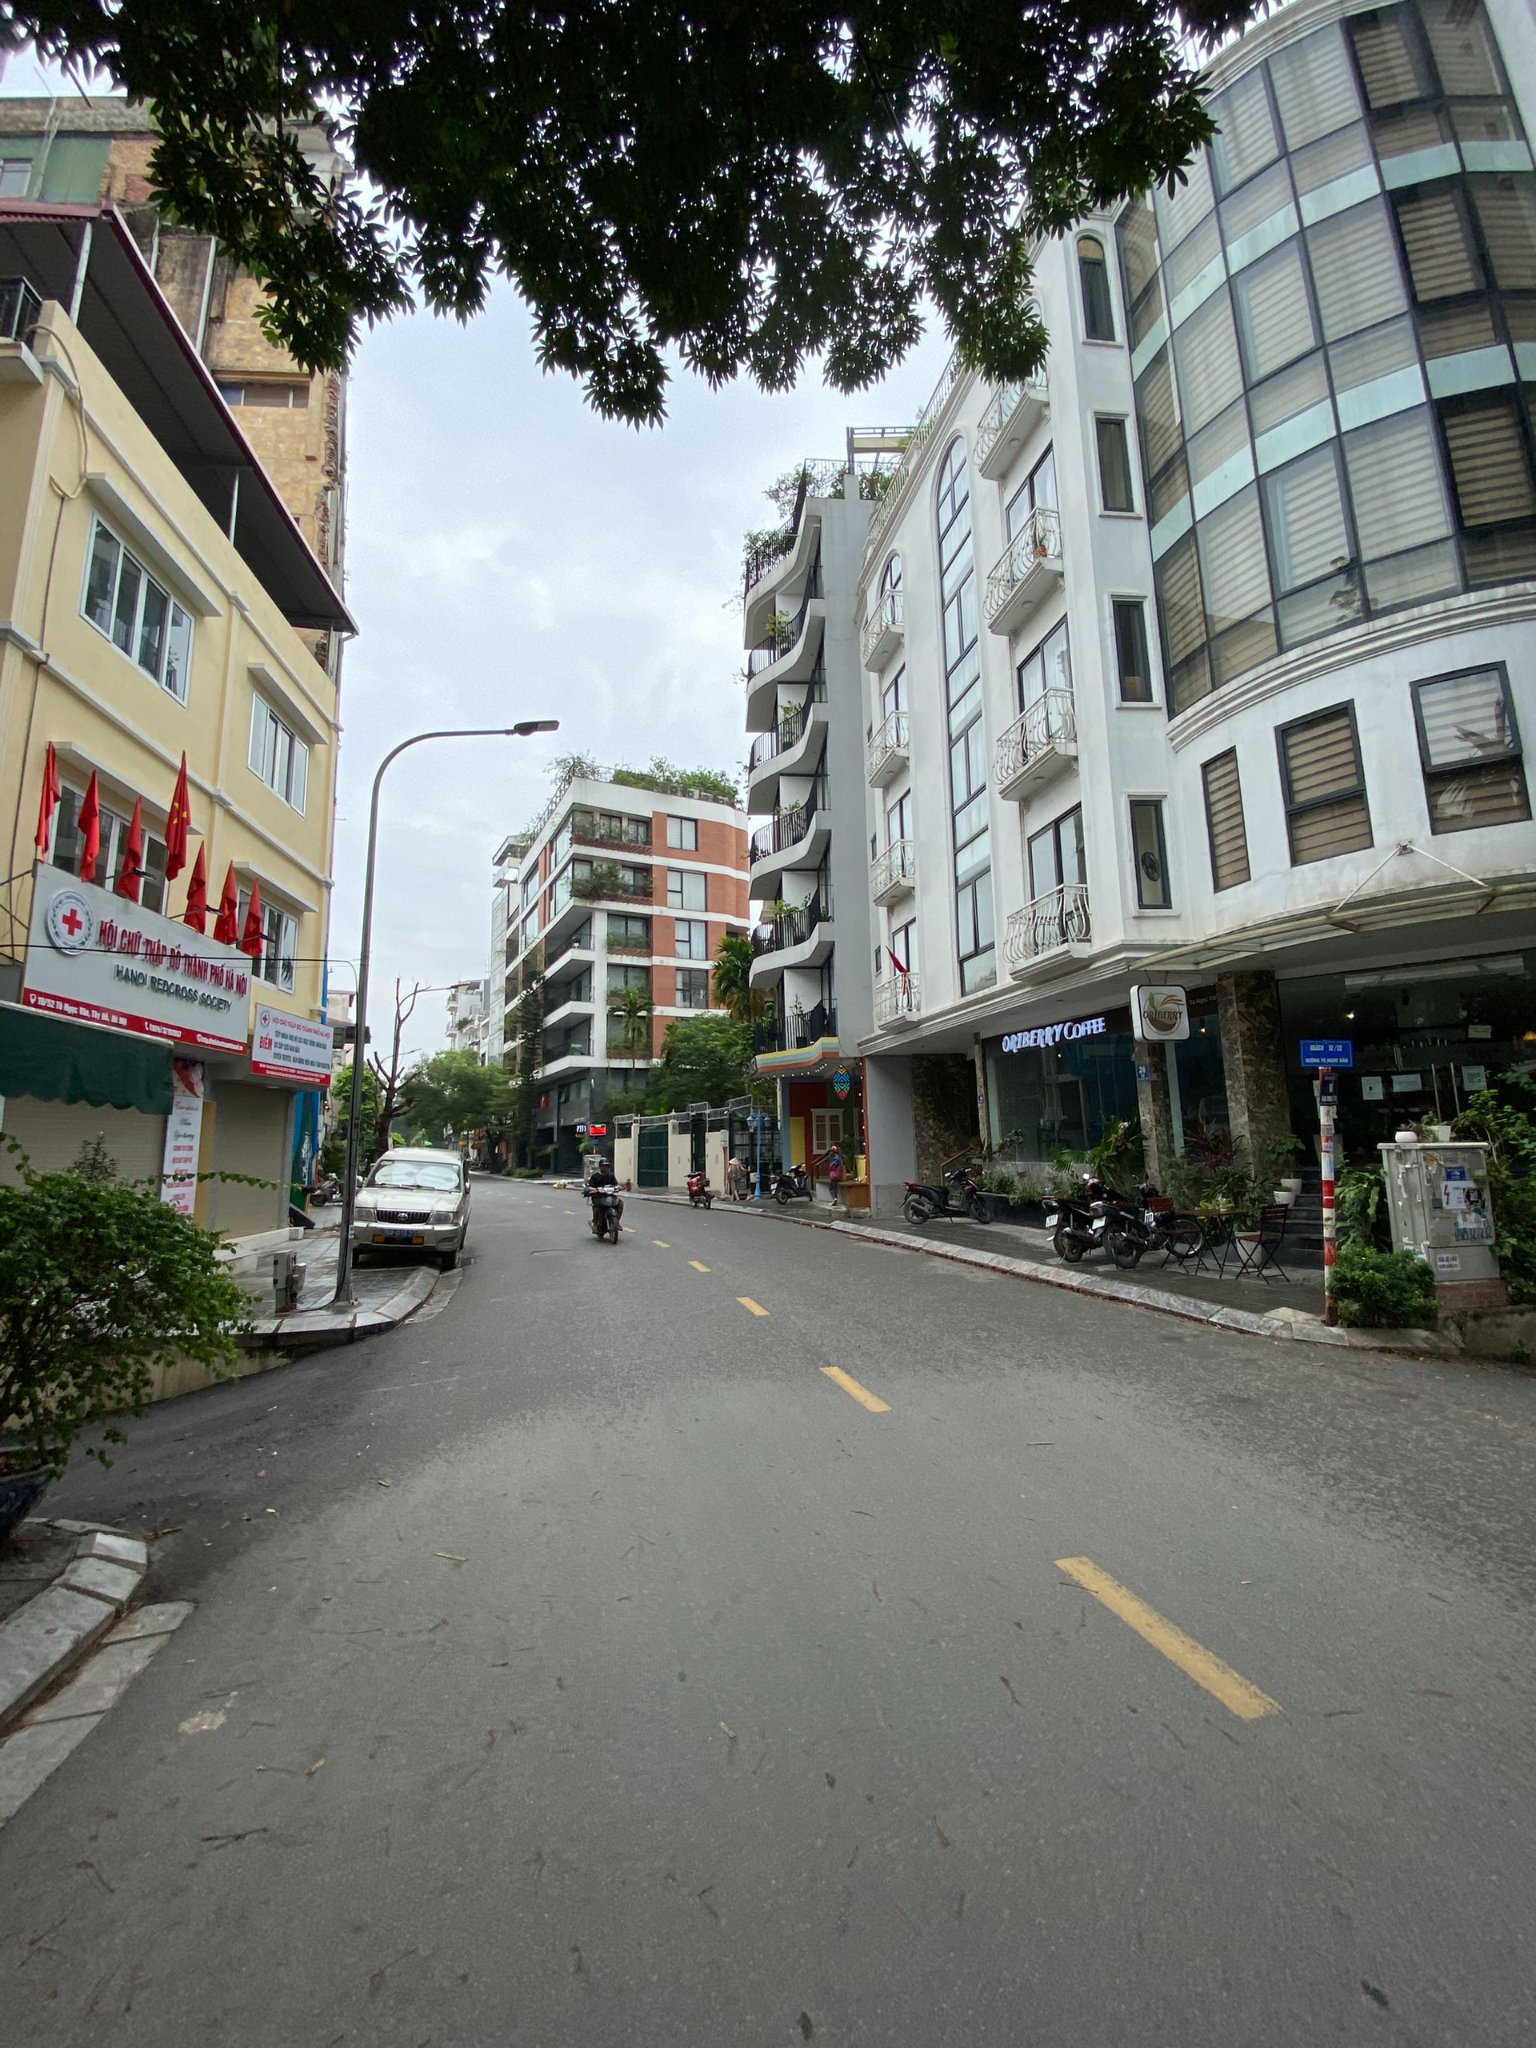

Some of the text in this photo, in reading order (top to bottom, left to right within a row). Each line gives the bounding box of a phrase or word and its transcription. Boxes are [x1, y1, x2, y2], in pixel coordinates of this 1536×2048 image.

[99, 919, 117, 951] HỘI
[120, 929, 142, 954] CHỮ
[209, 963, 225, 986] PHỐ
[225, 968, 234, 990] HÀ
[236, 973, 247, 998] NỘI
[116, 964, 232, 1012] HANOI REDCROSS SOCIETY
[1143, 1011, 1183, 1019] ORIBERRY
[1002, 1024, 1064, 1053] ORIBERRY
